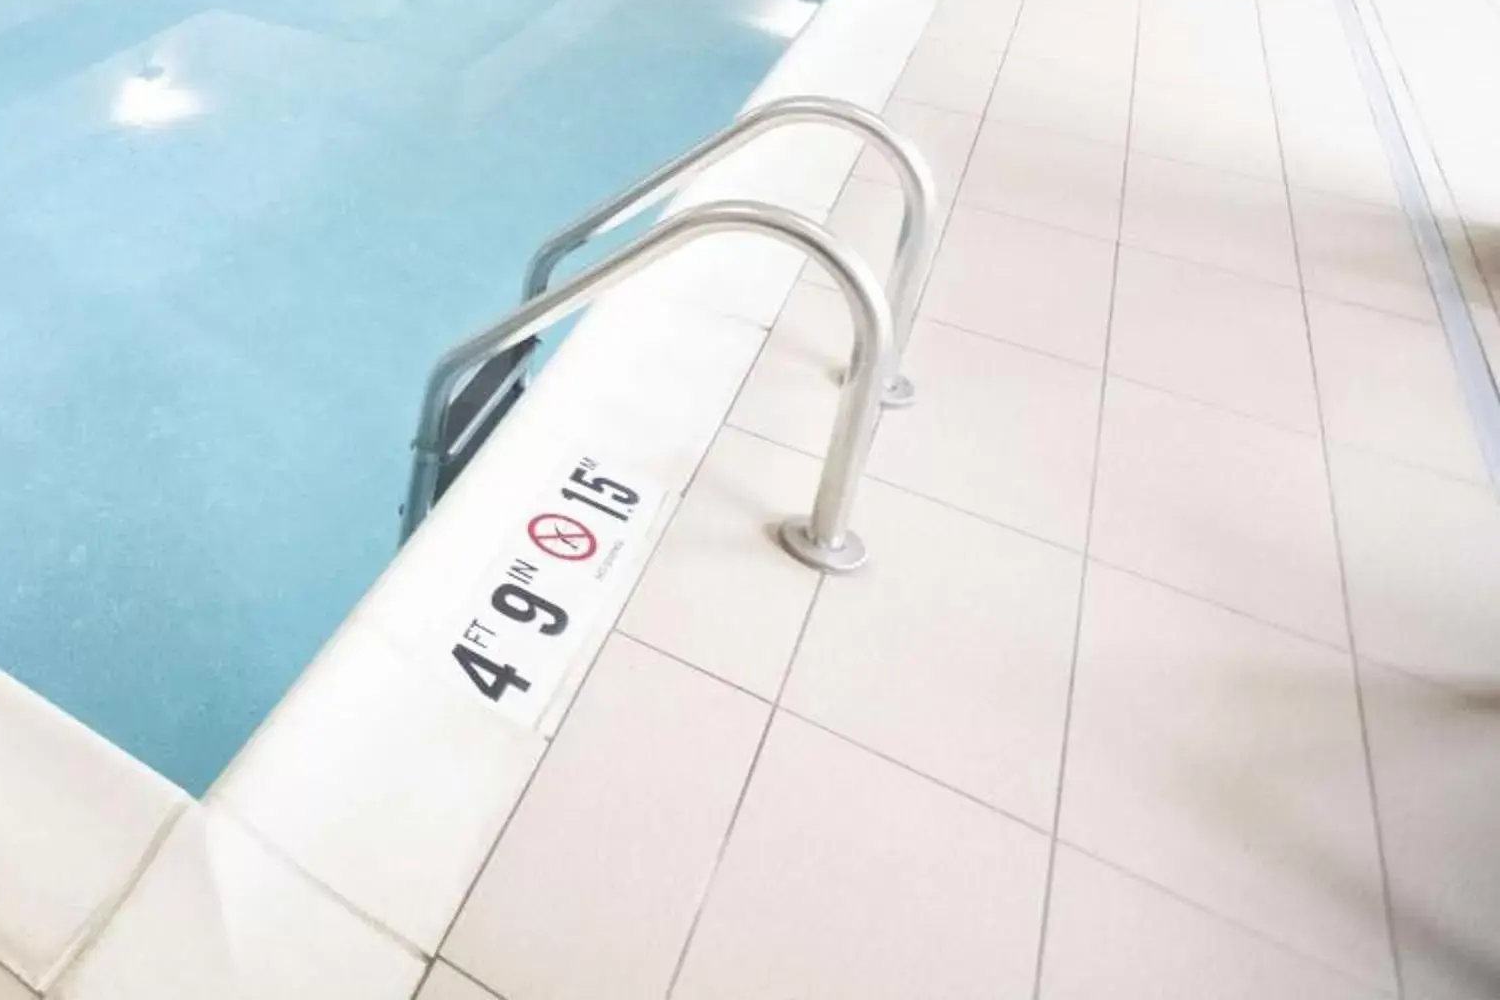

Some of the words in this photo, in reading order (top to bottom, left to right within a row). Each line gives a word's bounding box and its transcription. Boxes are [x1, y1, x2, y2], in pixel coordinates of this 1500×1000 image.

[505, 557, 540, 586] IN
[490, 583, 569, 637] 9
[462, 617, 497, 649] FT
[451, 643, 532, 702] 4
